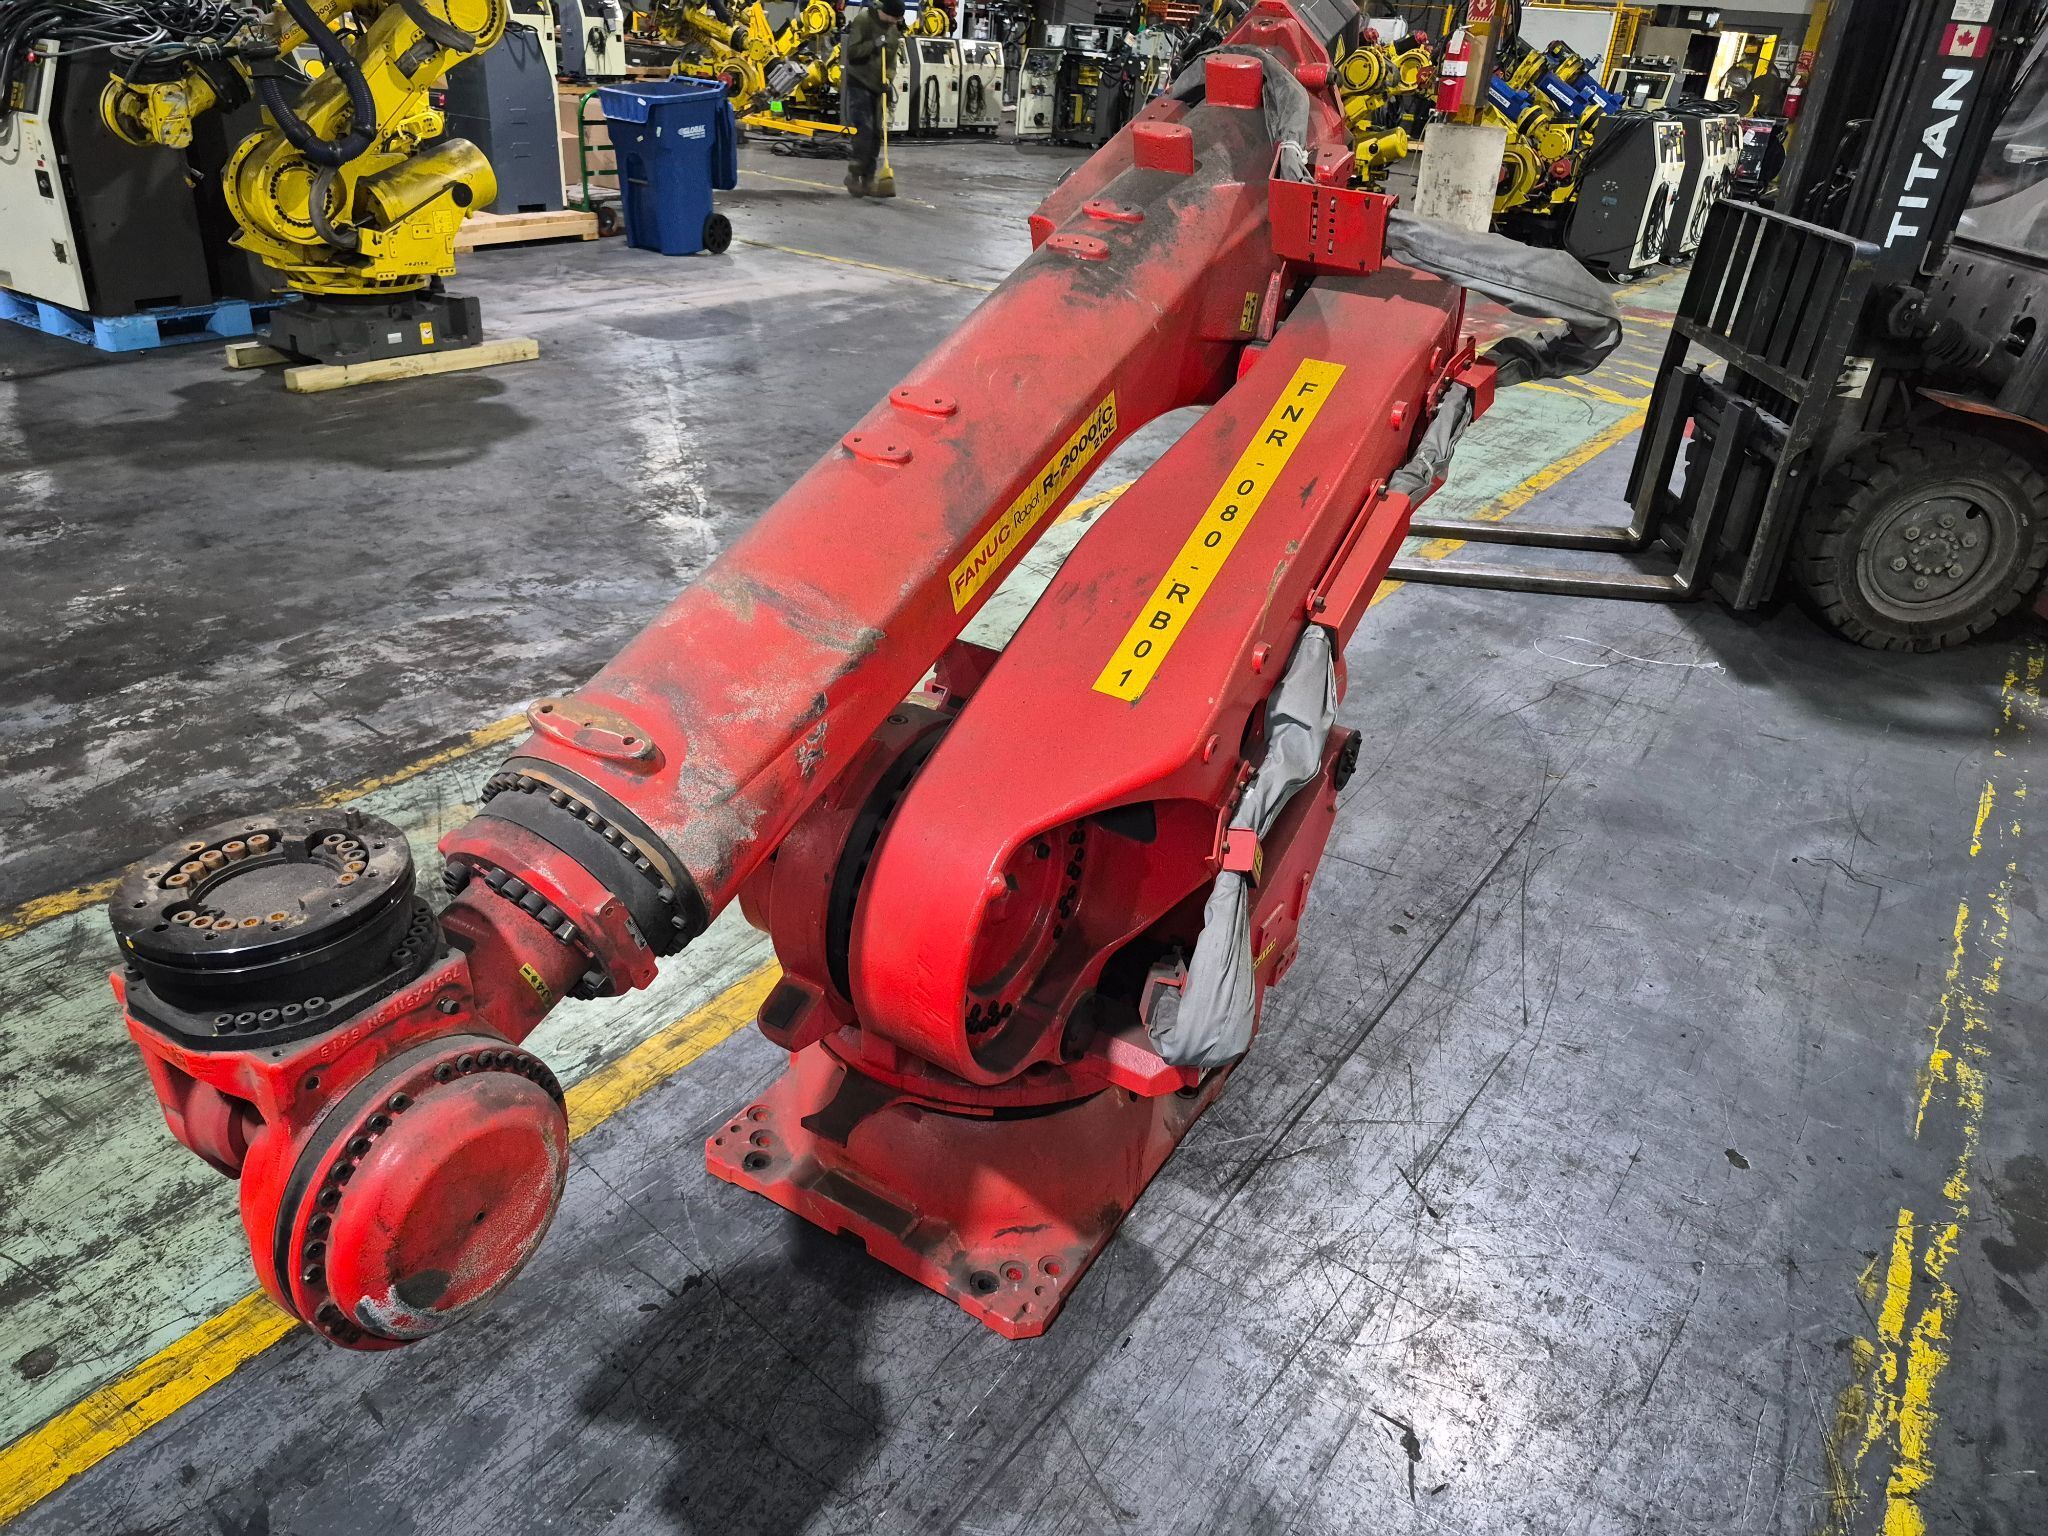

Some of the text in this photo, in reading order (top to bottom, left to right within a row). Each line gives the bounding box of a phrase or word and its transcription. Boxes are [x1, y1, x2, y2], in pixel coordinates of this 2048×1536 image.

[1884, 68, 1974, 248] TITAN
[1093, 423, 1115, 449] 210L
[954, 524, 1011, 597] FANUC
[1013, 492, 1040, 529] Robot
